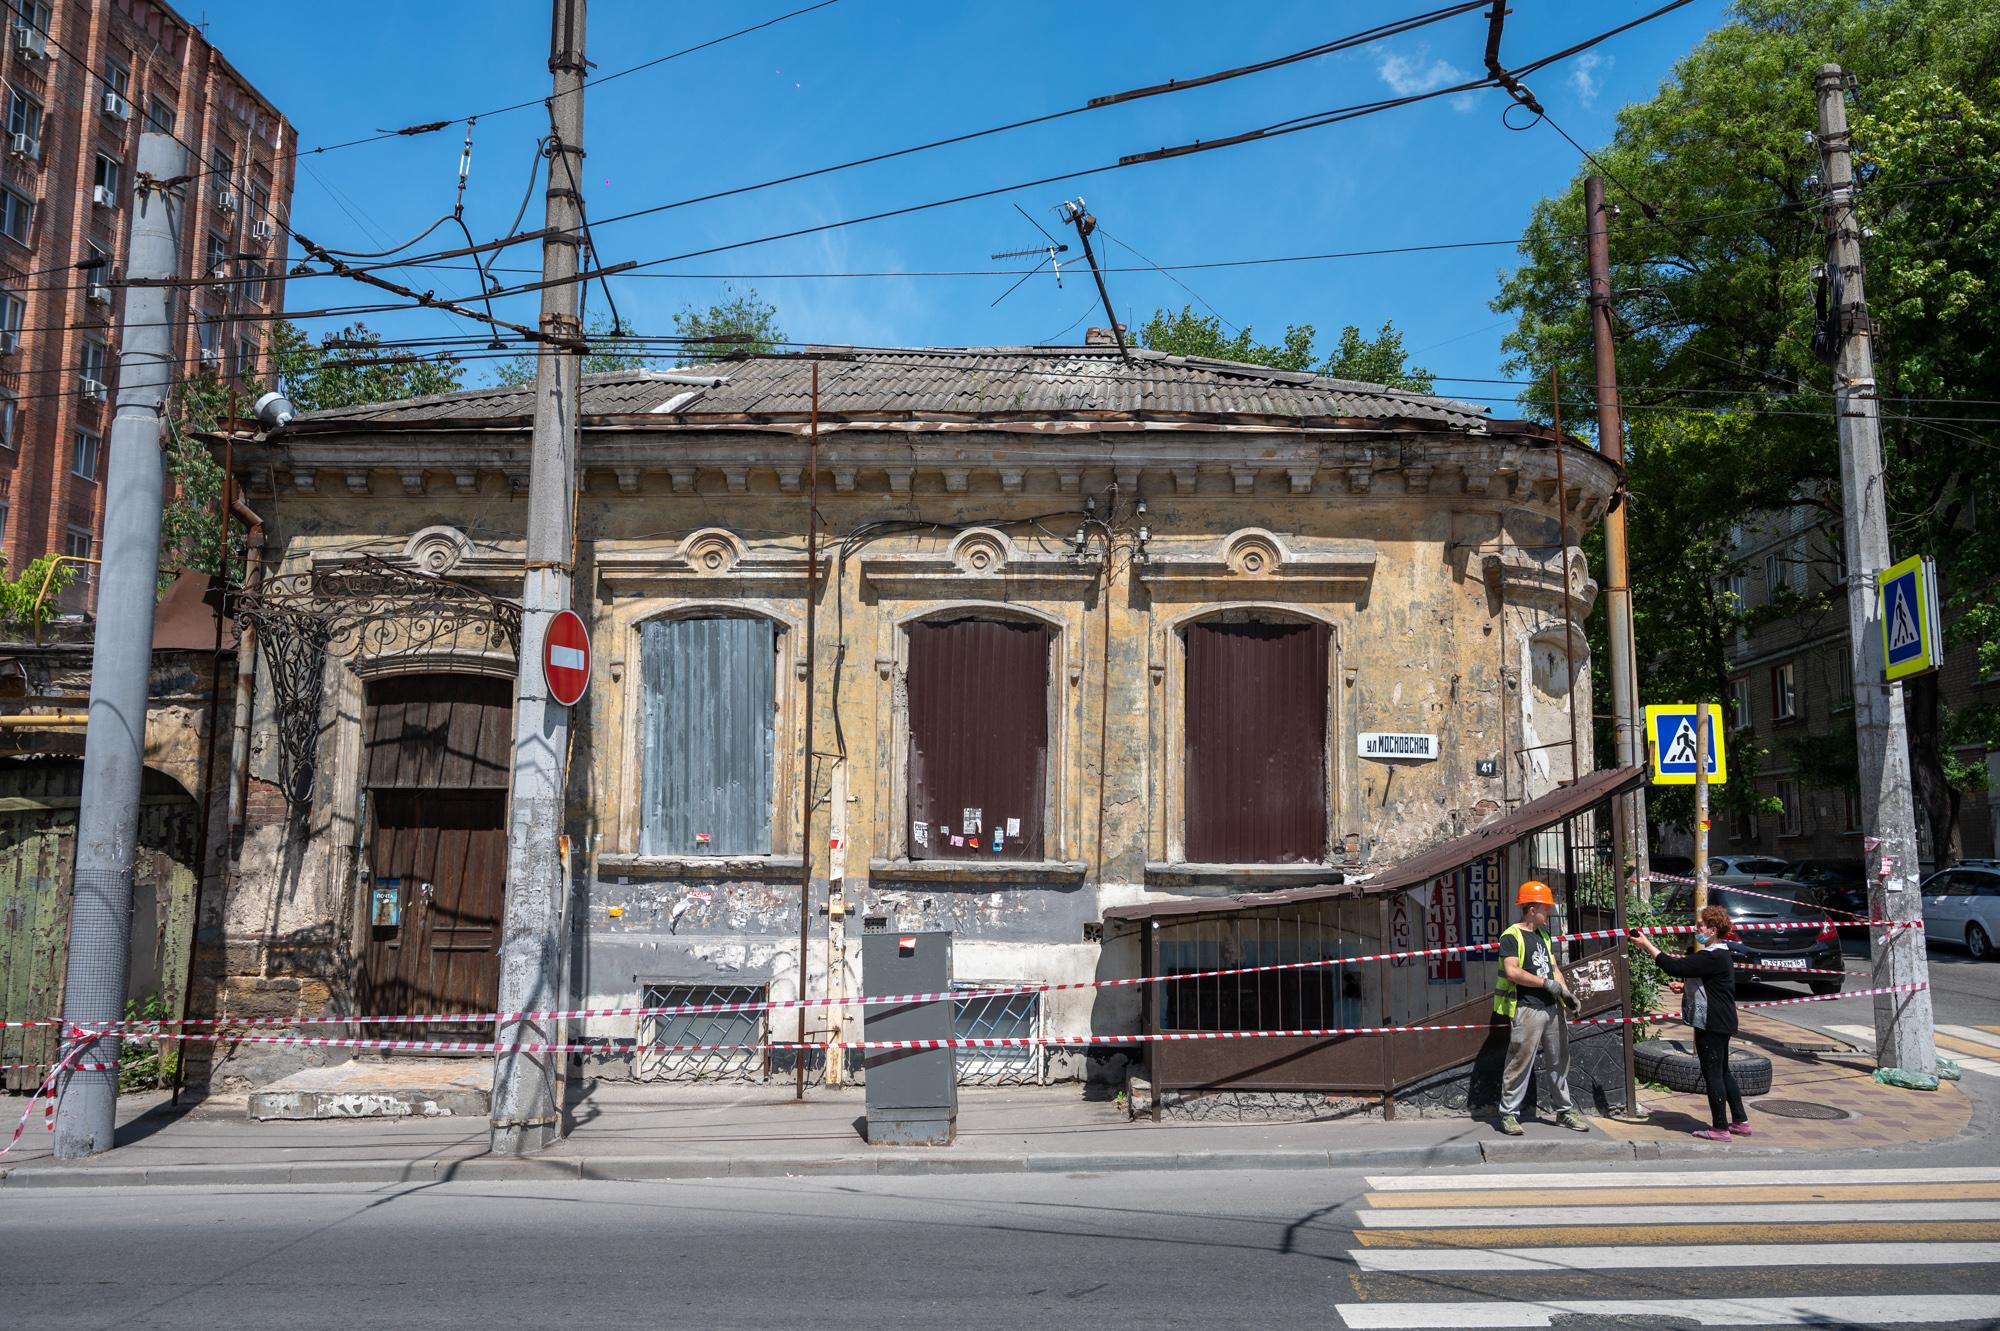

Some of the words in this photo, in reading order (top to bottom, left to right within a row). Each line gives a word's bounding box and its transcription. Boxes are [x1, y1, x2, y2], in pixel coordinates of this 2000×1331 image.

[1378, 736, 1429, 754] МОСКОВСКАЯ
[1481, 763, 1492, 773] 41
[1469, 863, 1484, 953] ЕМОНТ
